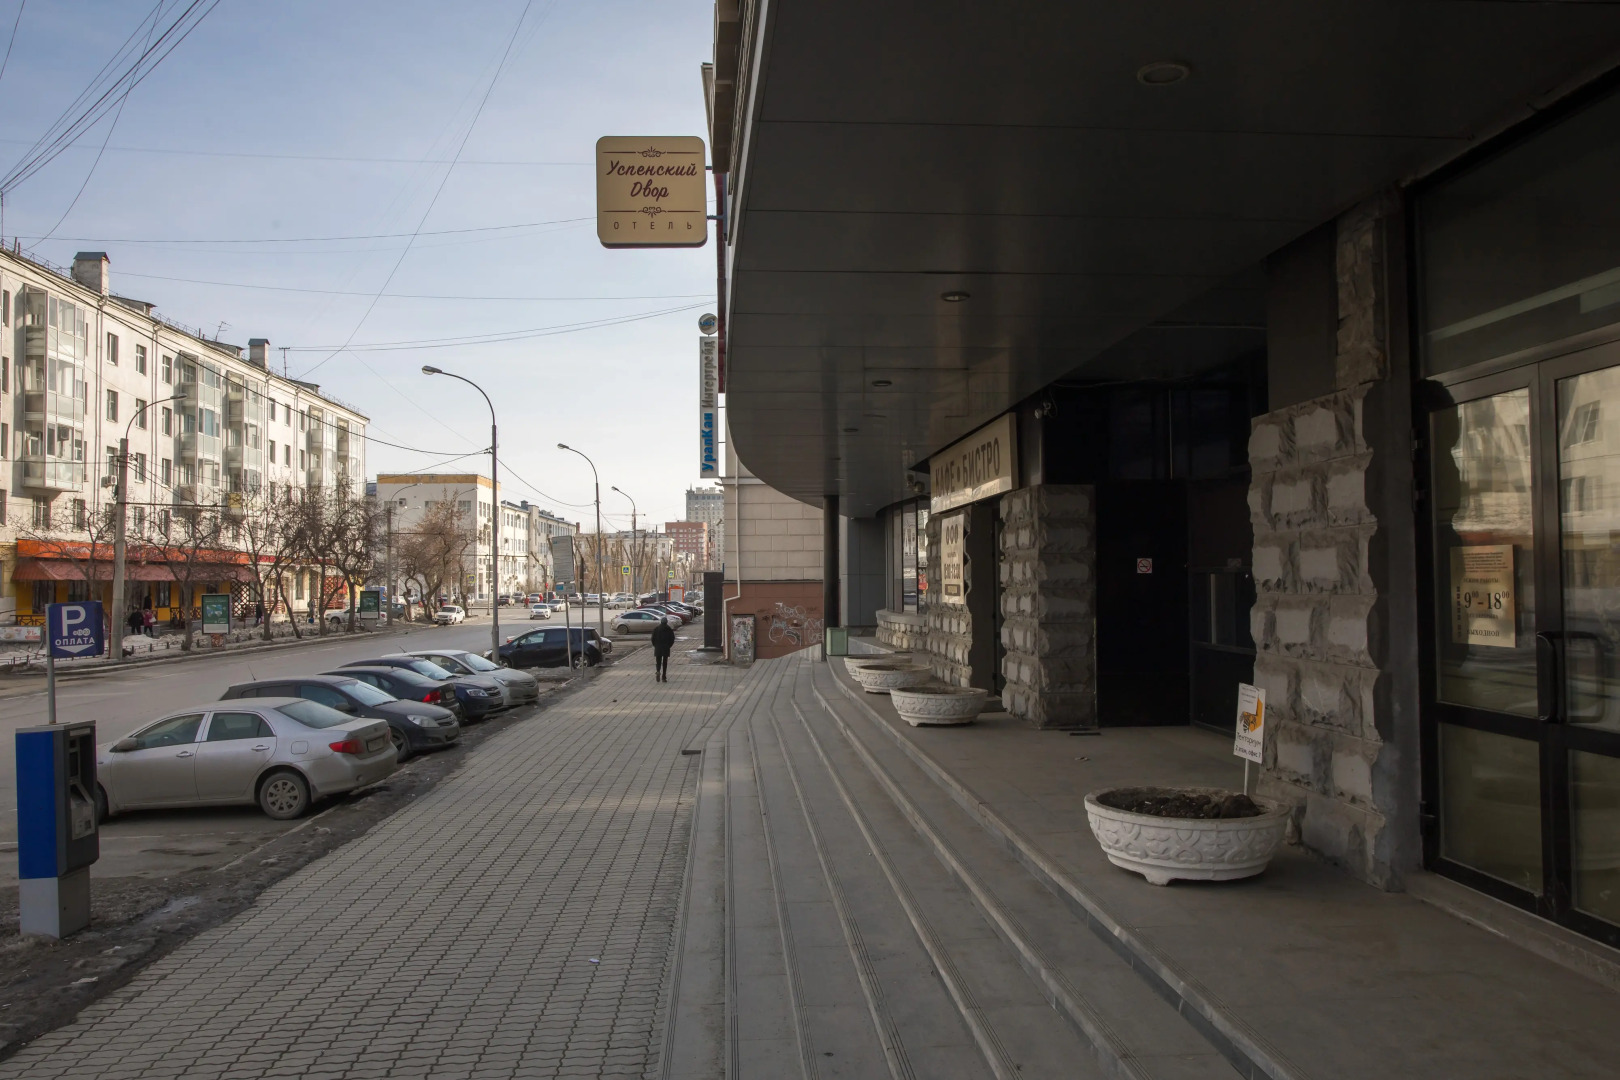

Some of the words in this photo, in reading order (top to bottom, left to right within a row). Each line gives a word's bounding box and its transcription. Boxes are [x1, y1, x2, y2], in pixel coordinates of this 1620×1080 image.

[606, 160, 698, 176] Успенский
[630, 179, 669, 202] Двор
[613, 221, 692, 230] ОТЕЛЬ
[935, 461, 955, 498] КАФЕ
[962, 437, 1001, 488] БИСТРО
[55, 637, 96, 646] ОПЛАТА
